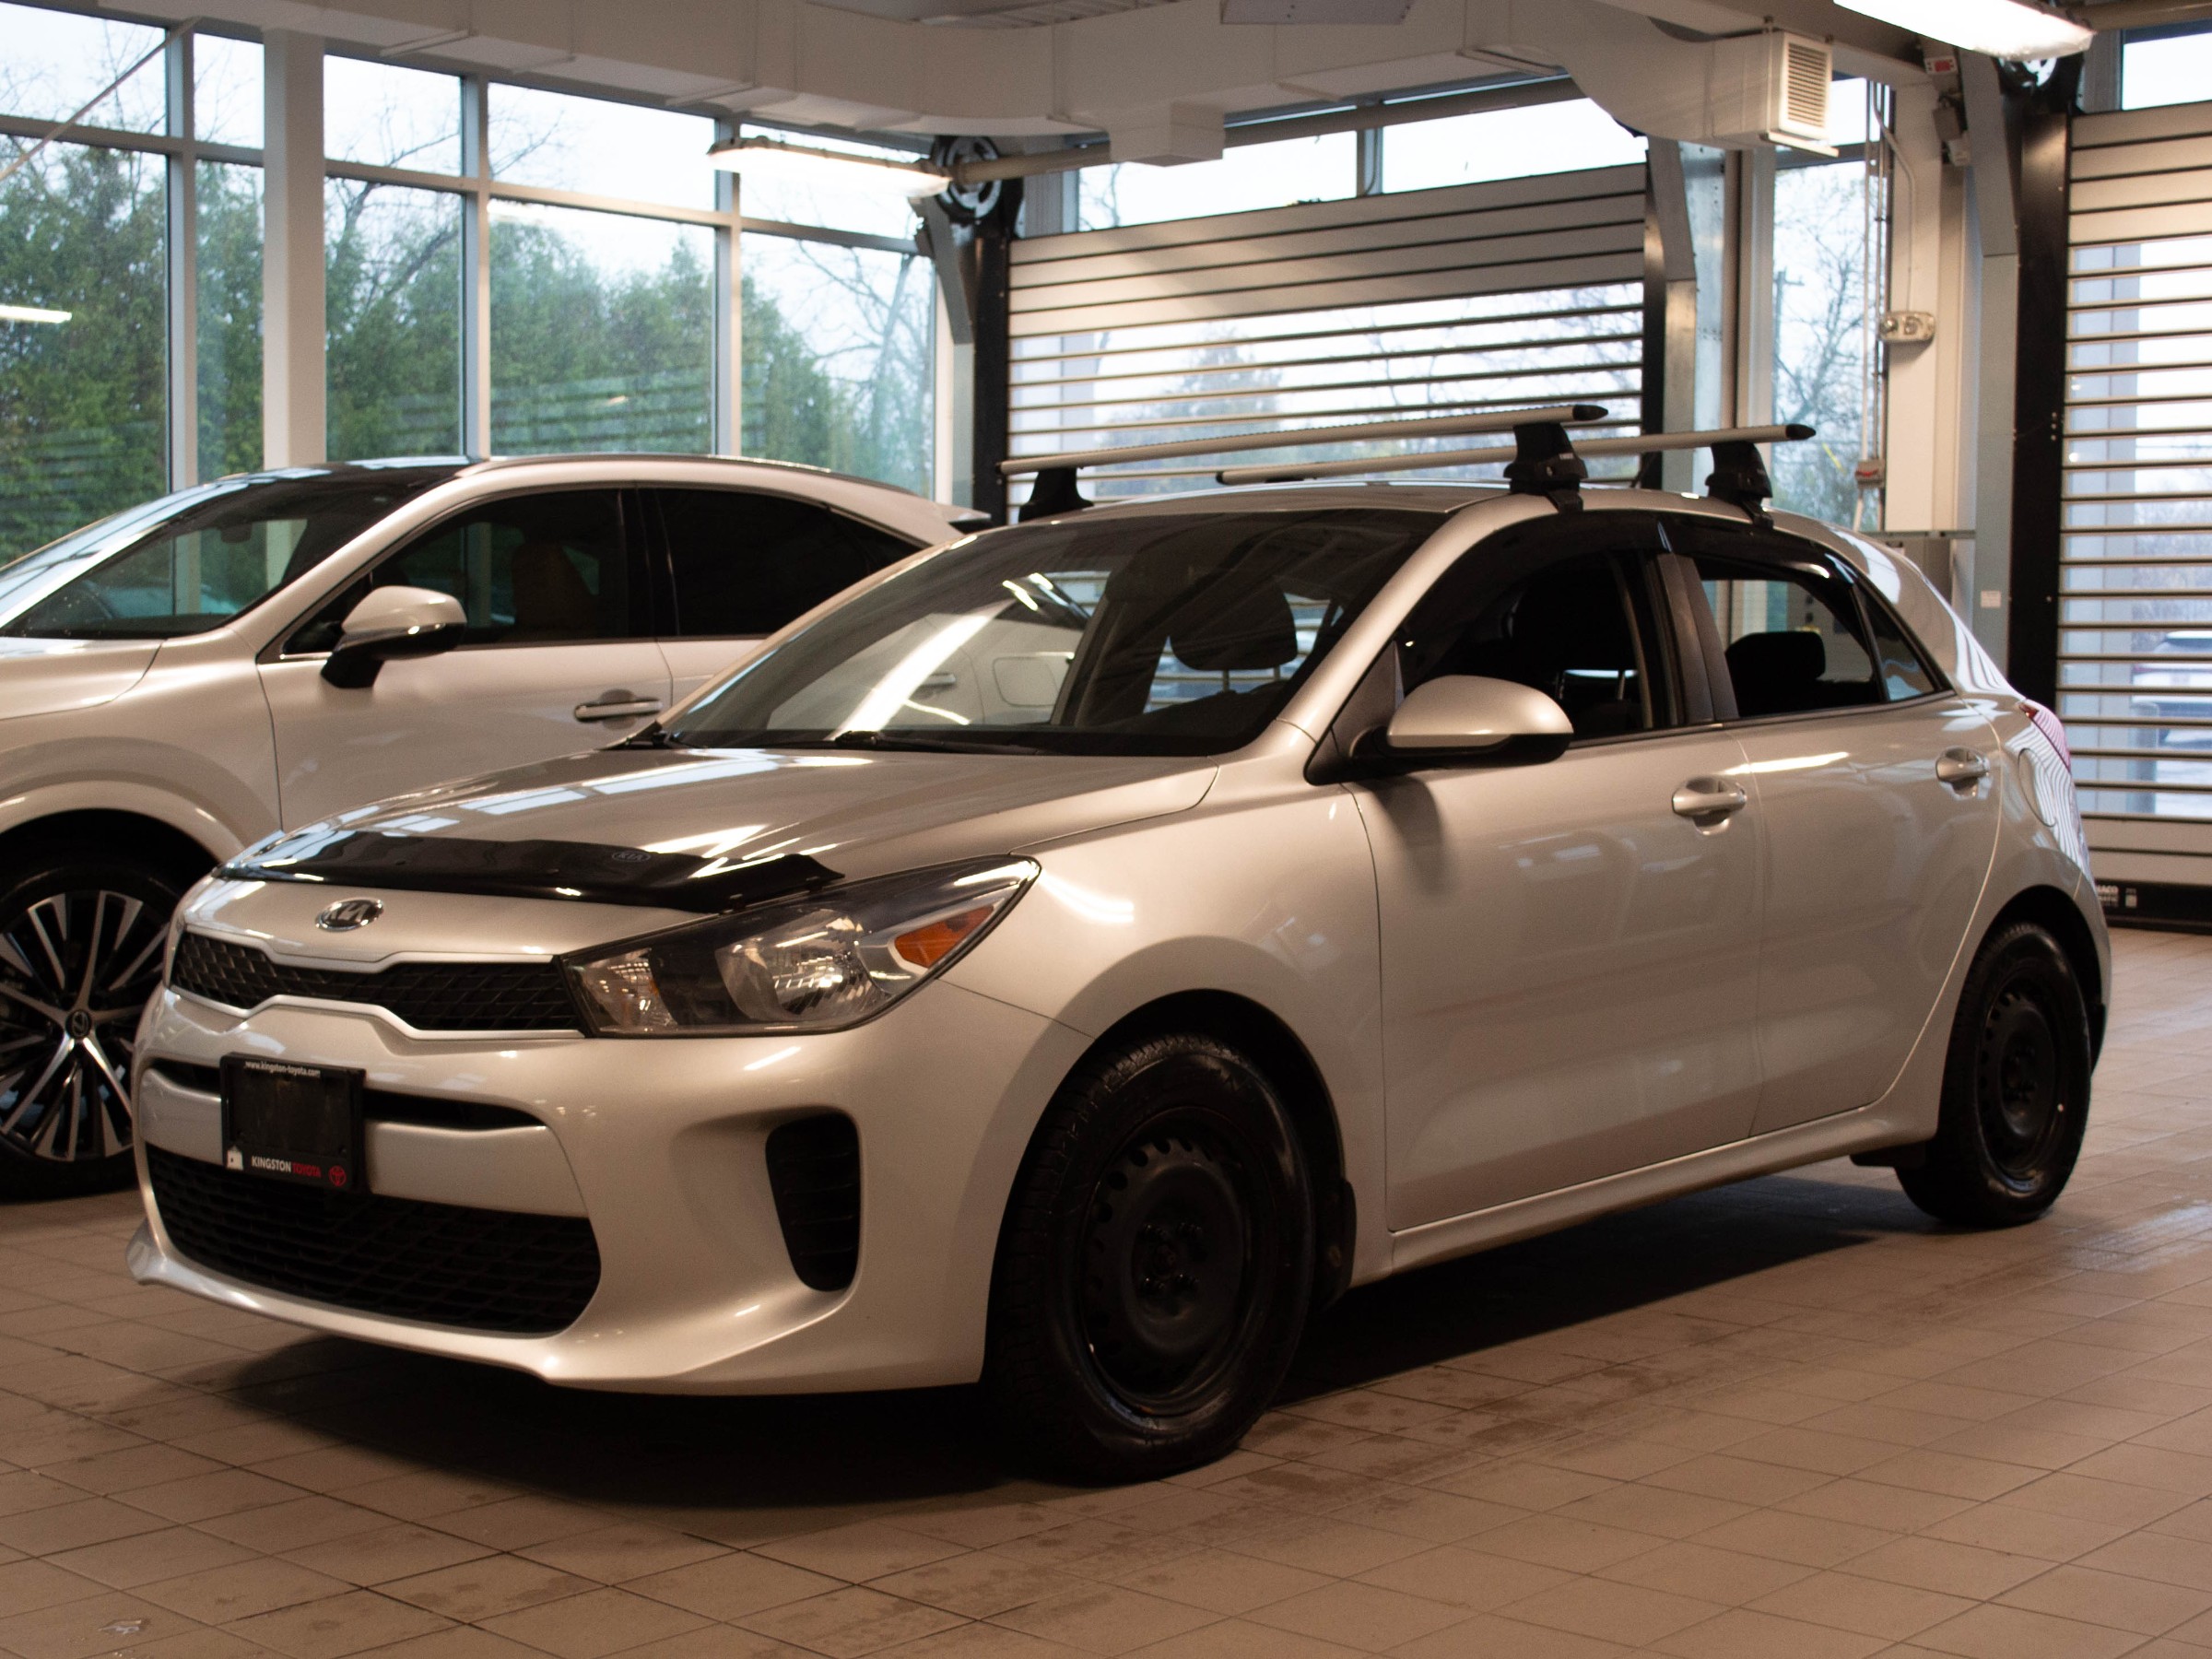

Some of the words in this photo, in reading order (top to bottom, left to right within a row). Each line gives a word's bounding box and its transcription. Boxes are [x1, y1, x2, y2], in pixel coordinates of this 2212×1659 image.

[244, 1061, 321, 1078] www.kingston-toyota.com
[252, 1156, 291, 1172] KINGSTON
[292, 1162, 322, 1177] TOYOTA
